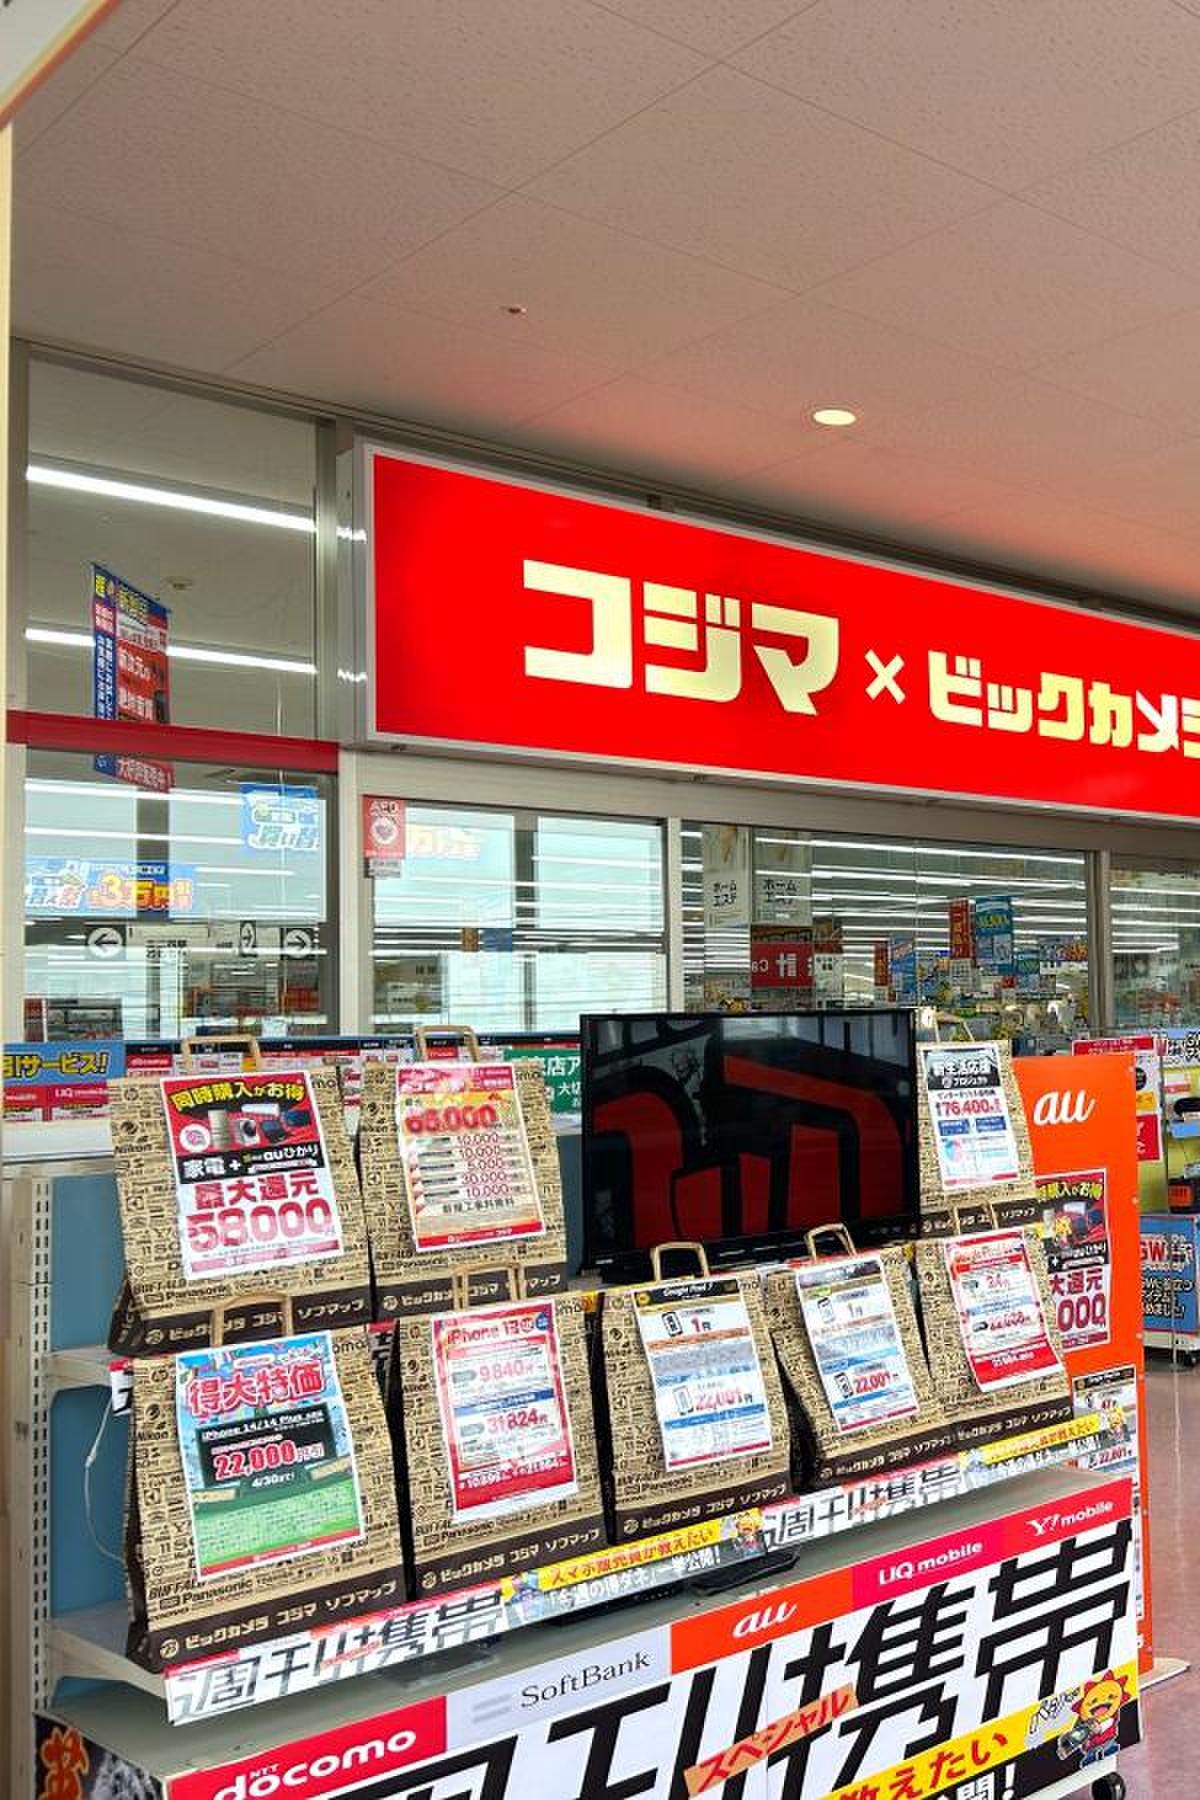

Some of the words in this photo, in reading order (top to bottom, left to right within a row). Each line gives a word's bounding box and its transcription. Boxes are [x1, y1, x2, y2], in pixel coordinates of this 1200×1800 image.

[523, 558, 840, 716] コジマ
[369, 800, 399, 817] AED
[1033, 1088, 1096, 1126] au
[182, 1156, 227, 1179] 家電
[194, 1170, 320, 1211] 最大還元
[165, 1284, 228, 1301] Panasonic
[168, 1316, 246, 1341] ビックメラ
[297, 1298, 365, 1320] ソフマップ
[446, 1325, 500, 1345] iPhone
[186, 1359, 327, 1417] 得大特価
[642, 1504, 701, 1529] ビックカメラ
[739, 1482, 787, 1502] ソフマップ
[439, 1552, 506, 1584] ビックカメラ
[510, 1542, 541, 1564] コジマ
[545, 1528, 600, 1551] ソフマップ
[878, 1560, 915, 1586] UQ
[916, 1540, 984, 1574] mobile
[181, 1578, 253, 1604] Panasonic
[184, 1615, 270, 1650] ビックカメラ
[276, 1601, 318, 1626] コジマ
[325, 1579, 398, 1612] ソフマップ
[731, 1599, 798, 1639] au
[519, 1650, 652, 1708] SoftBank
[698, 1690, 852, 1794] スペシャル
[213, 1728, 417, 1800] docomo
[248, 1763, 280, 1779] NTT
